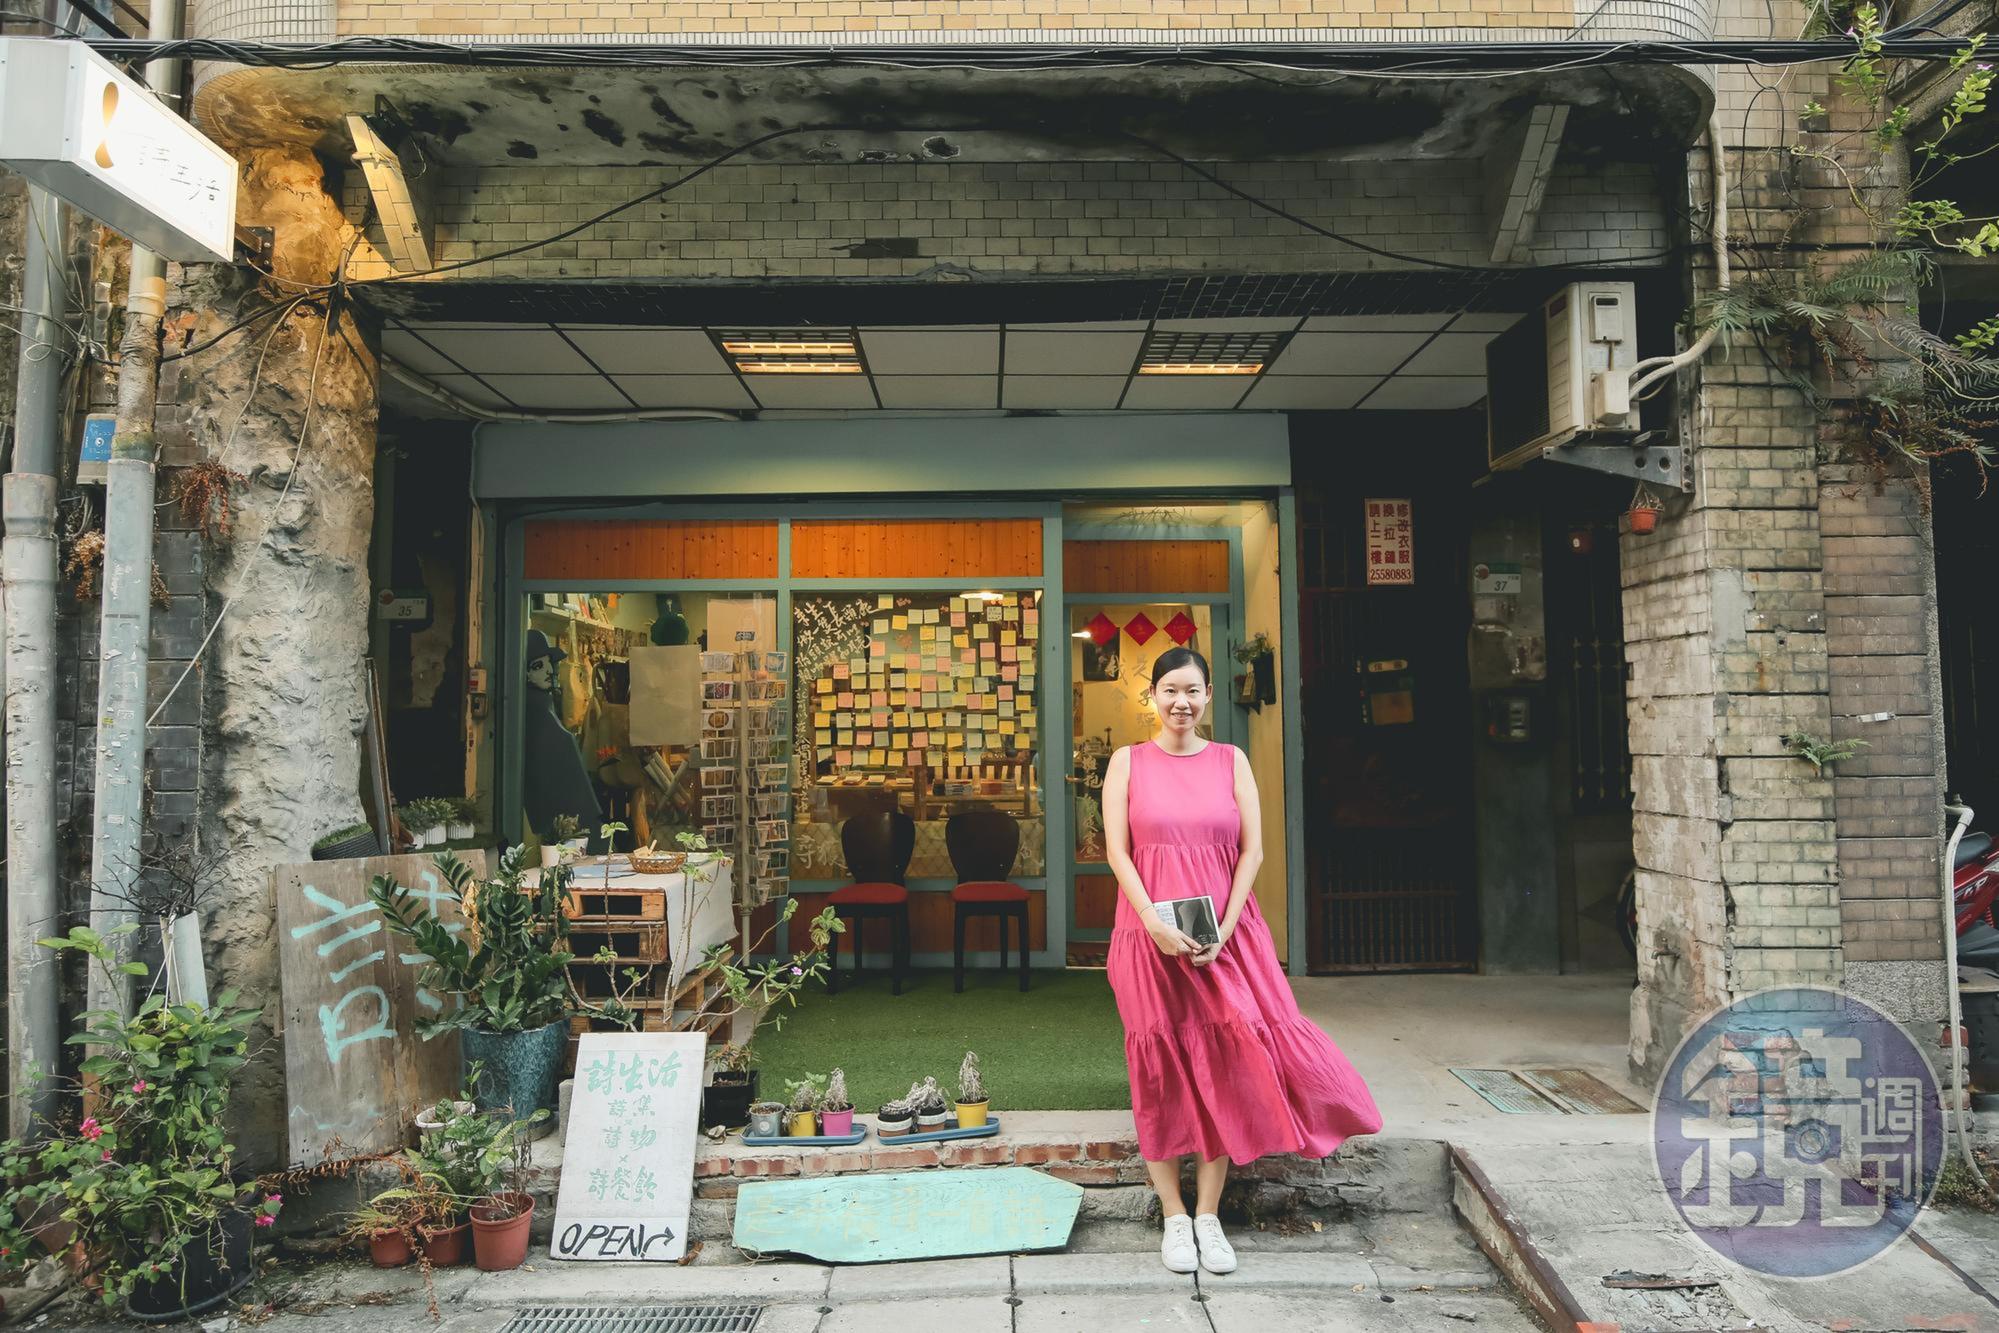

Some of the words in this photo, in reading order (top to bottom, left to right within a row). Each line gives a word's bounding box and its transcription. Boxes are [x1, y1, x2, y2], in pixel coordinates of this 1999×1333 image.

[1369, 503, 1382, 564] 請上二樓
[1397, 503, 1410, 564] 修改衣服
[1370, 569, 1412, 580] 25580883
[1494, 580, 1508, 593] 37
[398, 605, 412, 617] 35
[583, 1050, 683, 1096] 詩生活
[603, 1125, 657, 1152] 詩物
[588, 1166, 659, 1202] 詩餐飲
[559, 1222, 645, 1258] OPEN
